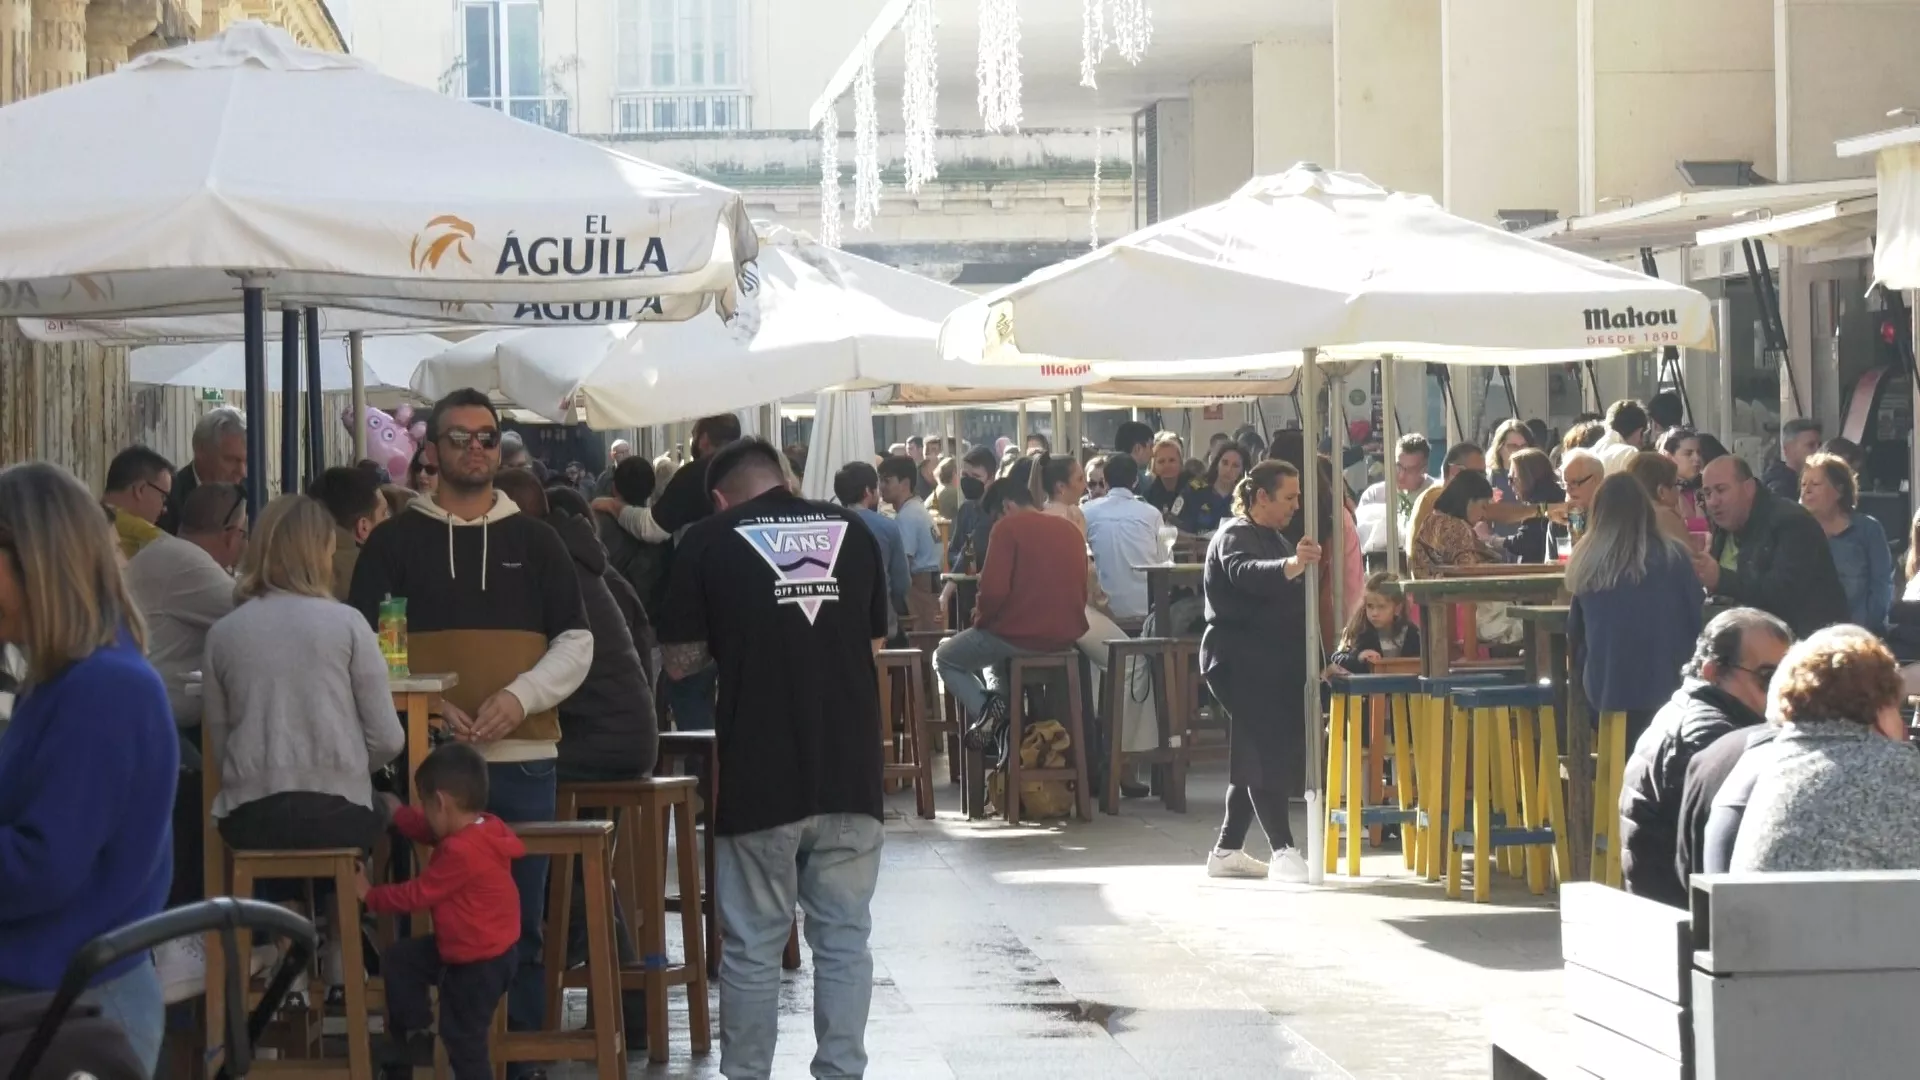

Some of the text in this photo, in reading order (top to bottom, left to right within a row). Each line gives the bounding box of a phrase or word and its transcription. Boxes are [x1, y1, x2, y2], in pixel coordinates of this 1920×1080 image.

[586, 214, 611, 234] EL
[495, 229, 669, 276] ÁGUILA
[1582, 306, 1678, 330] Mahou
[1586, 331, 1679, 346] DESDE 1890
[756, 512, 827, 524] THE ORIGINAL
[761, 528, 832, 553] VANS
[774, 583, 840, 597] OFF THE WALL
